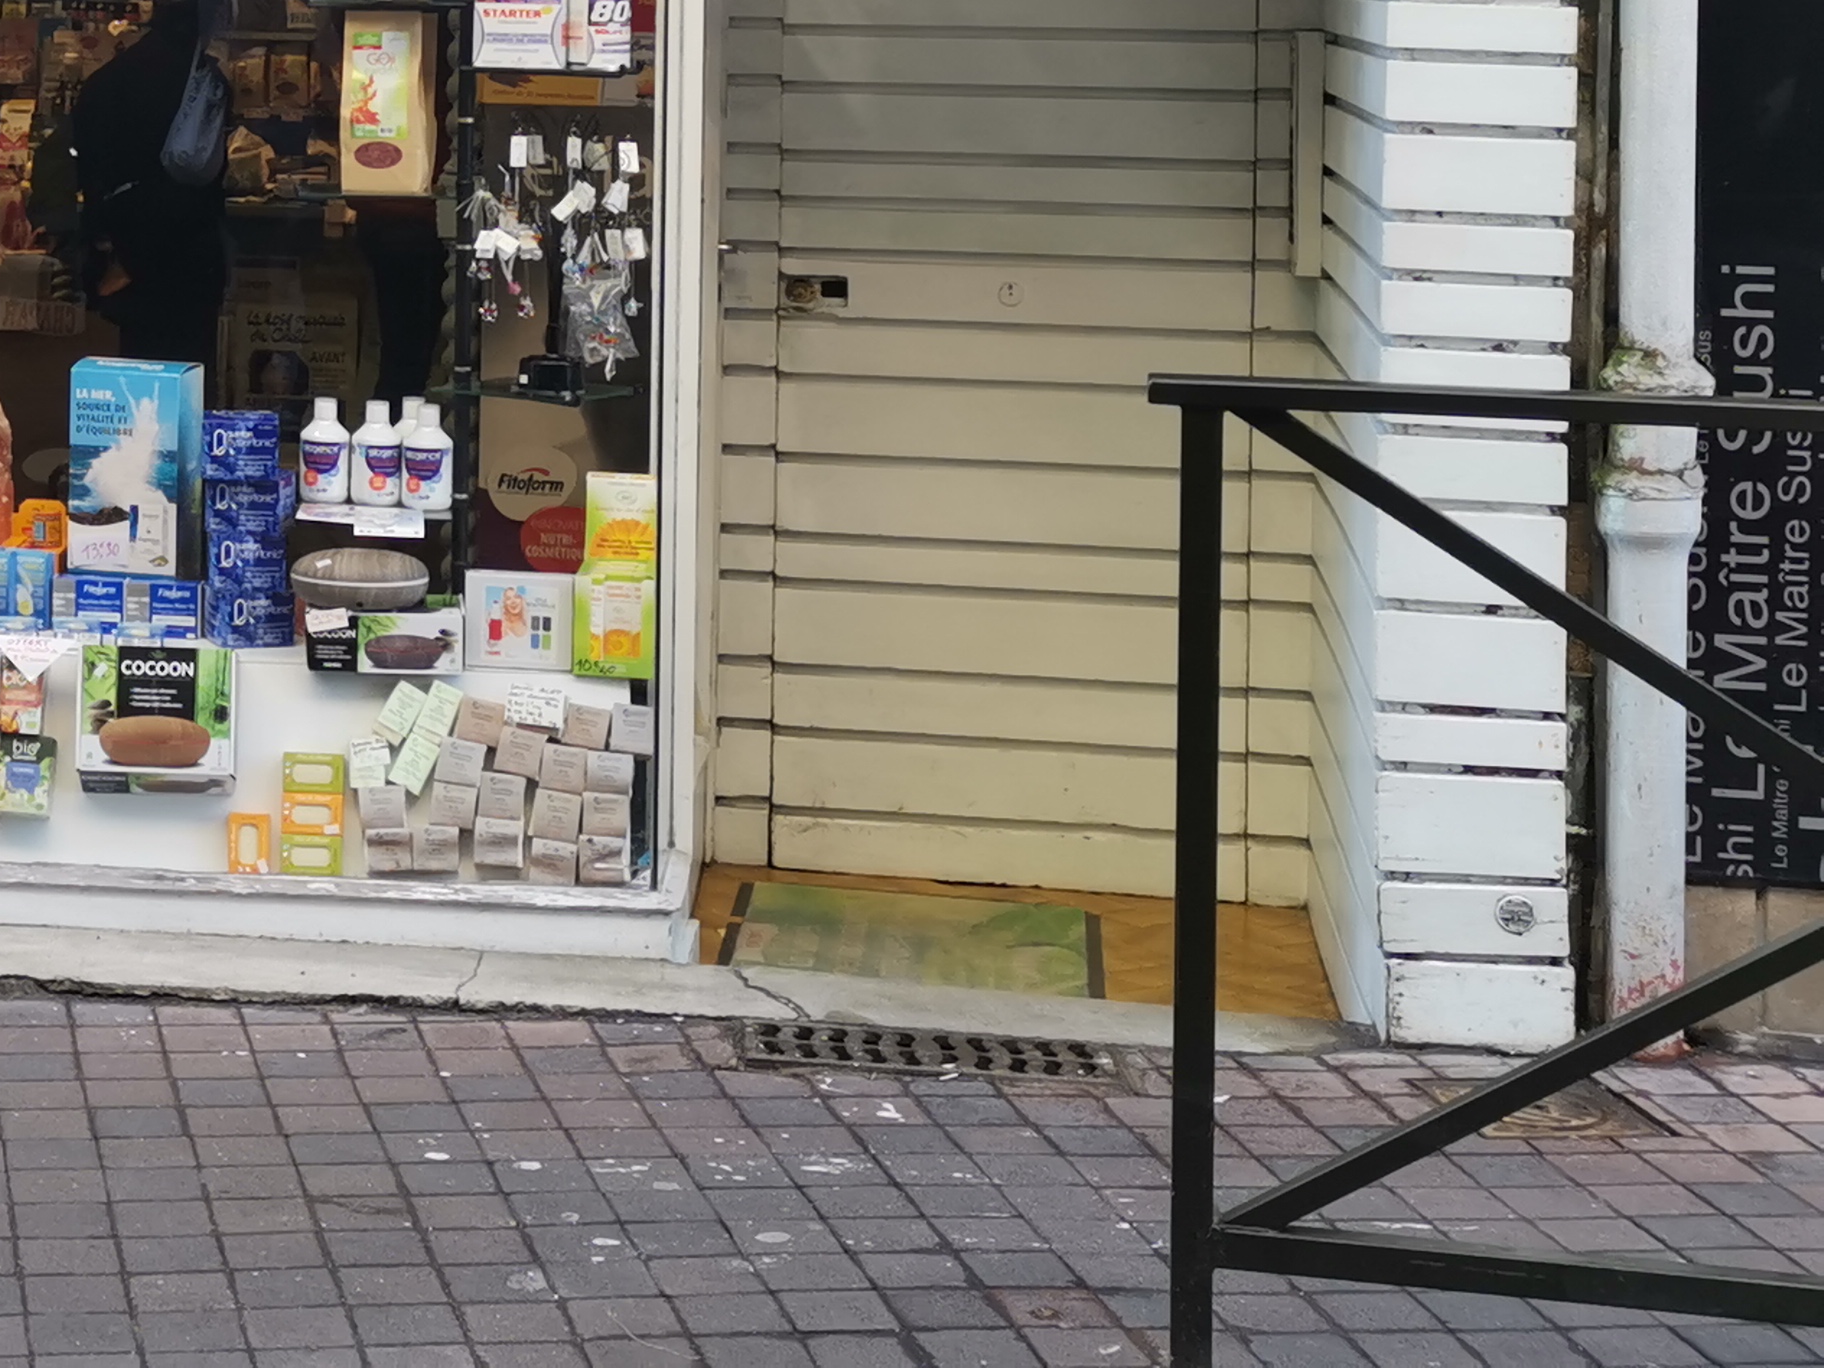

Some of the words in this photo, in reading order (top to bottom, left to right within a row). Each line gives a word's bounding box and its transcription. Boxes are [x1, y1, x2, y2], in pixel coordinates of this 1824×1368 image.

[483, 8, 542, 19] STARTER
[75, 388, 88, 399] LA
[75, 401, 111, 412] SOURCE
[114, 403, 126, 413] DE
[497, 473, 564, 495] Fitoform
[1713, 482, 1771, 691] Maître
[1774, 519, 1811, 646] Maître
[121, 660, 194, 678] COCOON
[1774, 663, 1809, 713] Le
